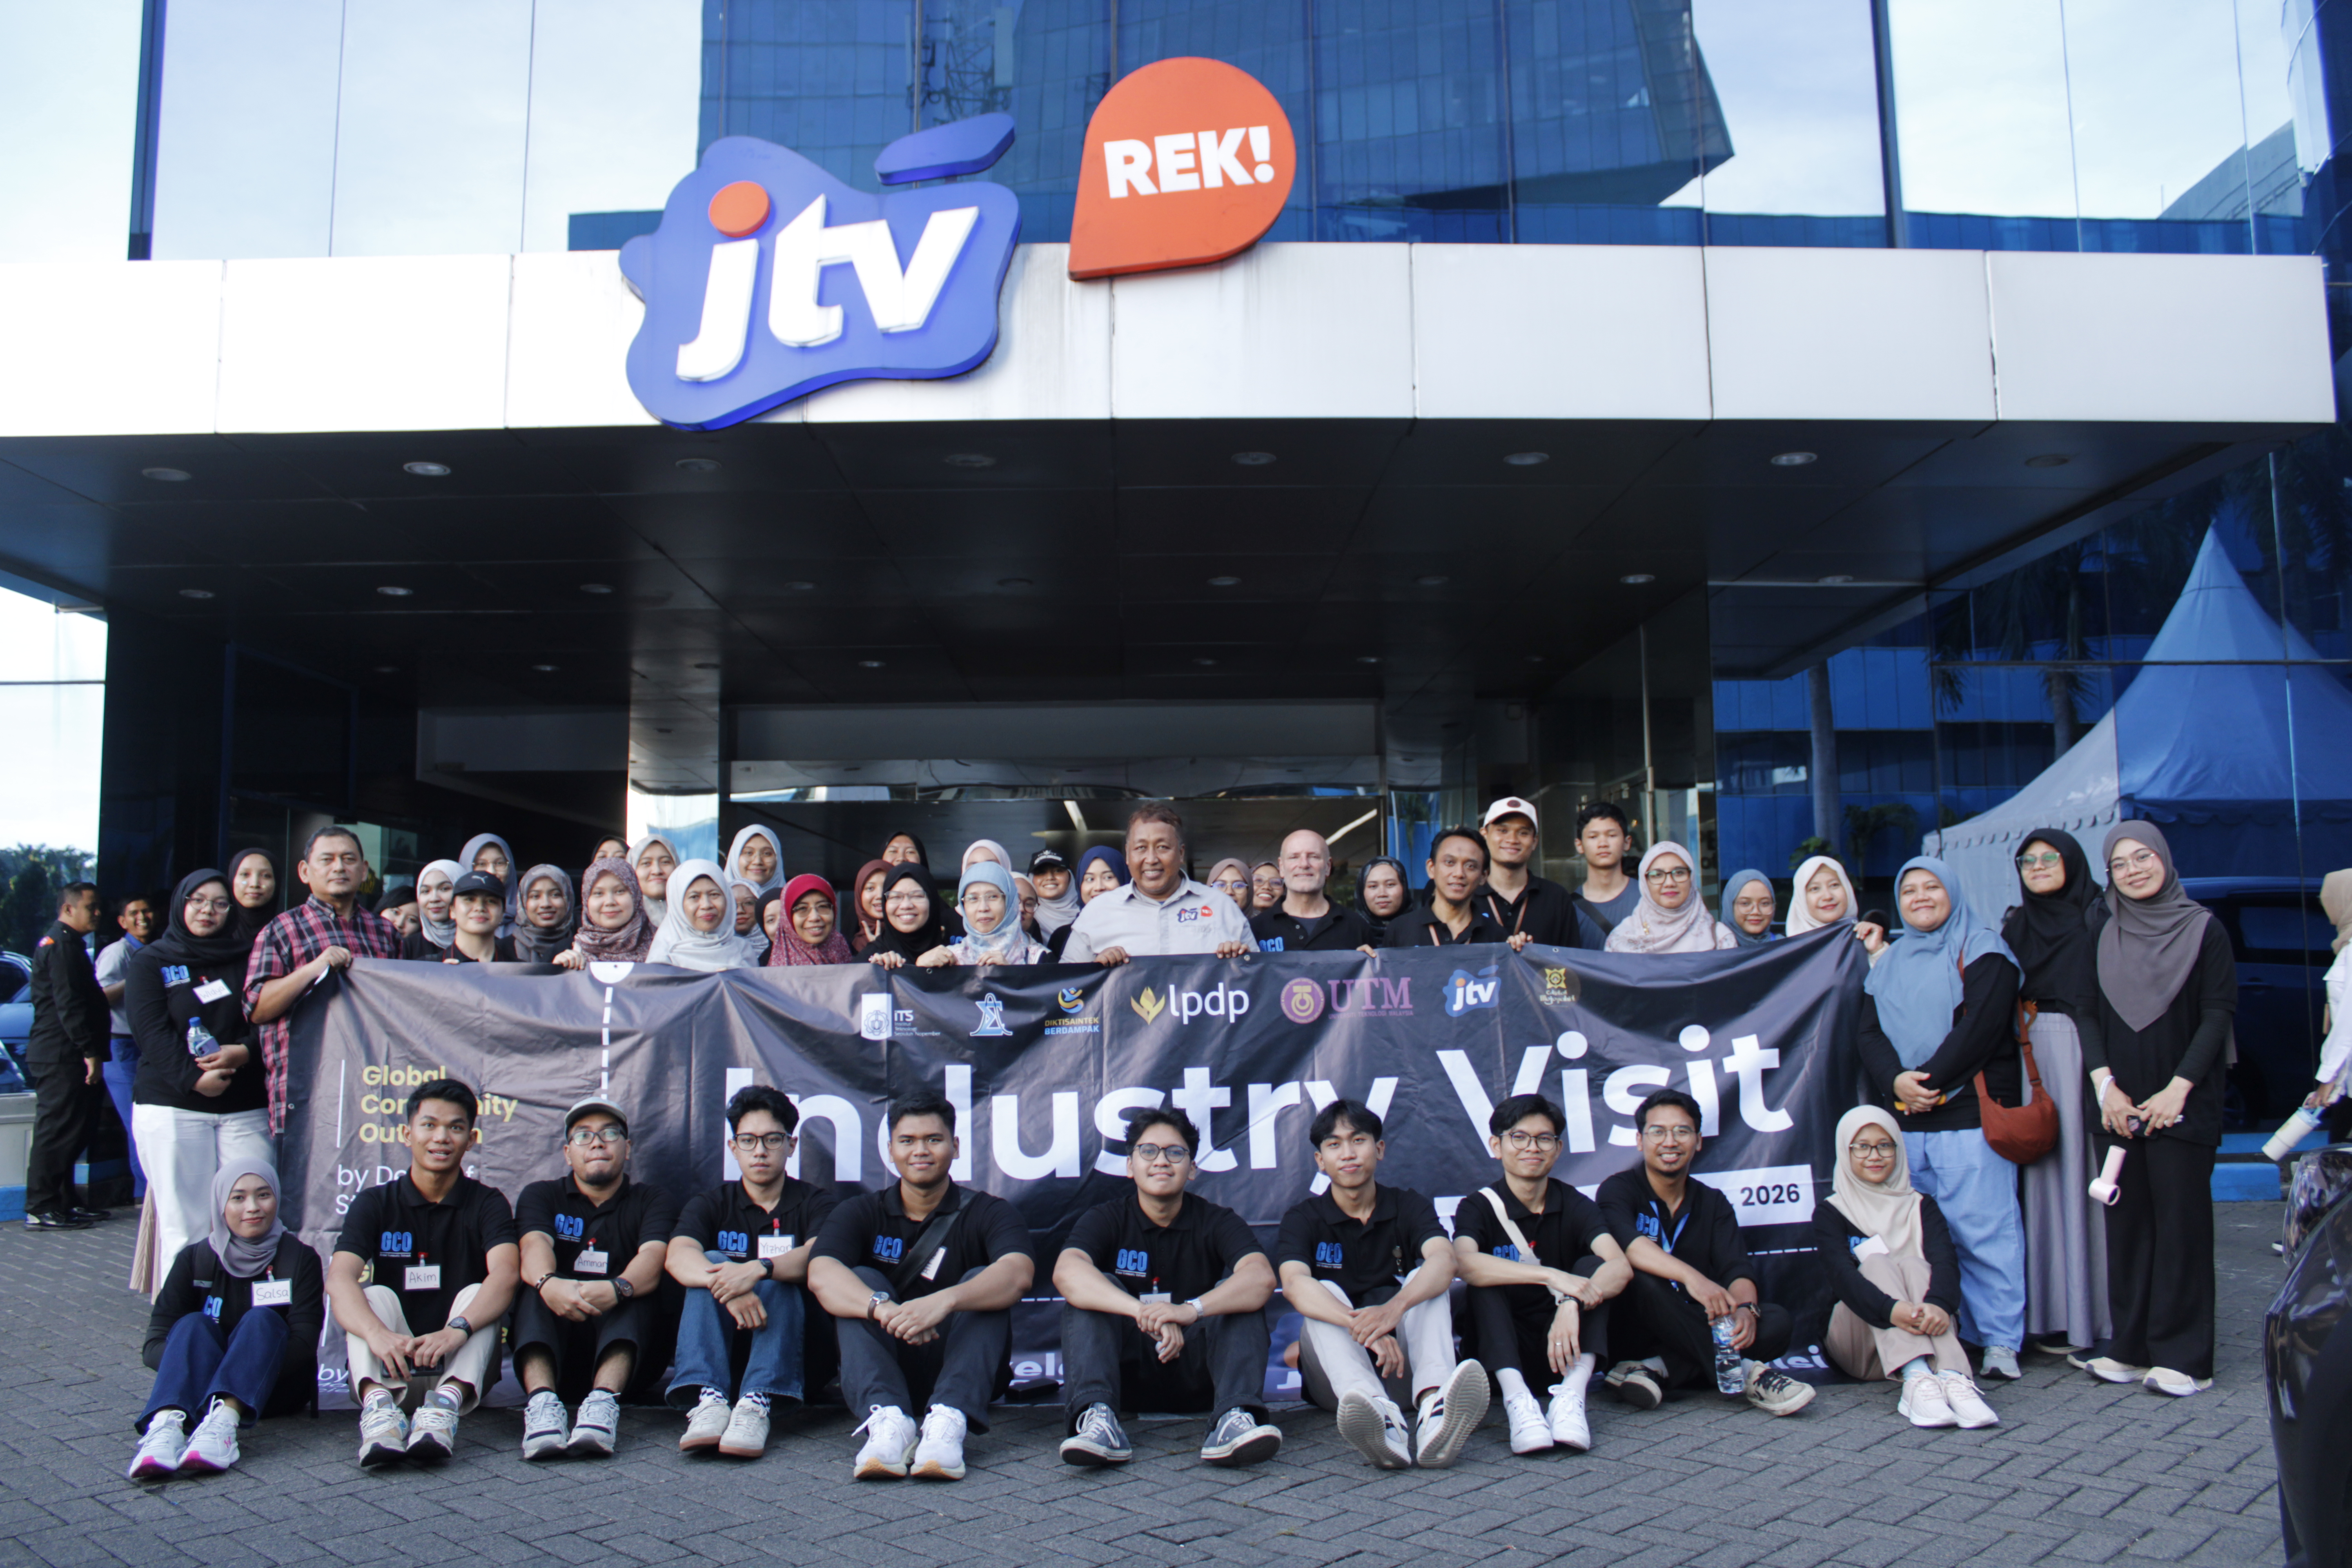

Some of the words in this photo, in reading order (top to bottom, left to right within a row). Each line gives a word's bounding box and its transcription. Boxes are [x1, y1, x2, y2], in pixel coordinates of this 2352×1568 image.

[1103, 125, 1275, 199] REK!
[675, 180, 980, 381] jtv
[161, 965, 190, 983] GCO
[1169, 982, 1249, 1025] lpdp
[1327, 977, 1413, 1013] UTM
[1453, 978, 1496, 1011] jtv
[1044, 1025, 1100, 1035] BERDAMPAK
[1045, 1017, 1099, 1027] DIKTISAINTEK
[362, 1065, 446, 1086] Global
[1436, 1024, 1795, 1158] Visit
[338, 1164, 369, 1192] by
[1740, 1183, 1800, 1206] 2026
[555, 1214, 583, 1237] GCO
[1636, 1212, 1659, 1236] GCO
[381, 1231, 412, 1252] GCO
[717, 1230, 748, 1252] GCO
[873, 1235, 902, 1258] GCO
[1316, 1241, 1343, 1263] GCO
[577, 1255, 608, 1267] Ammar
[1116, 1249, 1147, 1272] GCO
[410, 1272, 437, 1283] Akim
[256, 1287, 289, 1301] Salsa
